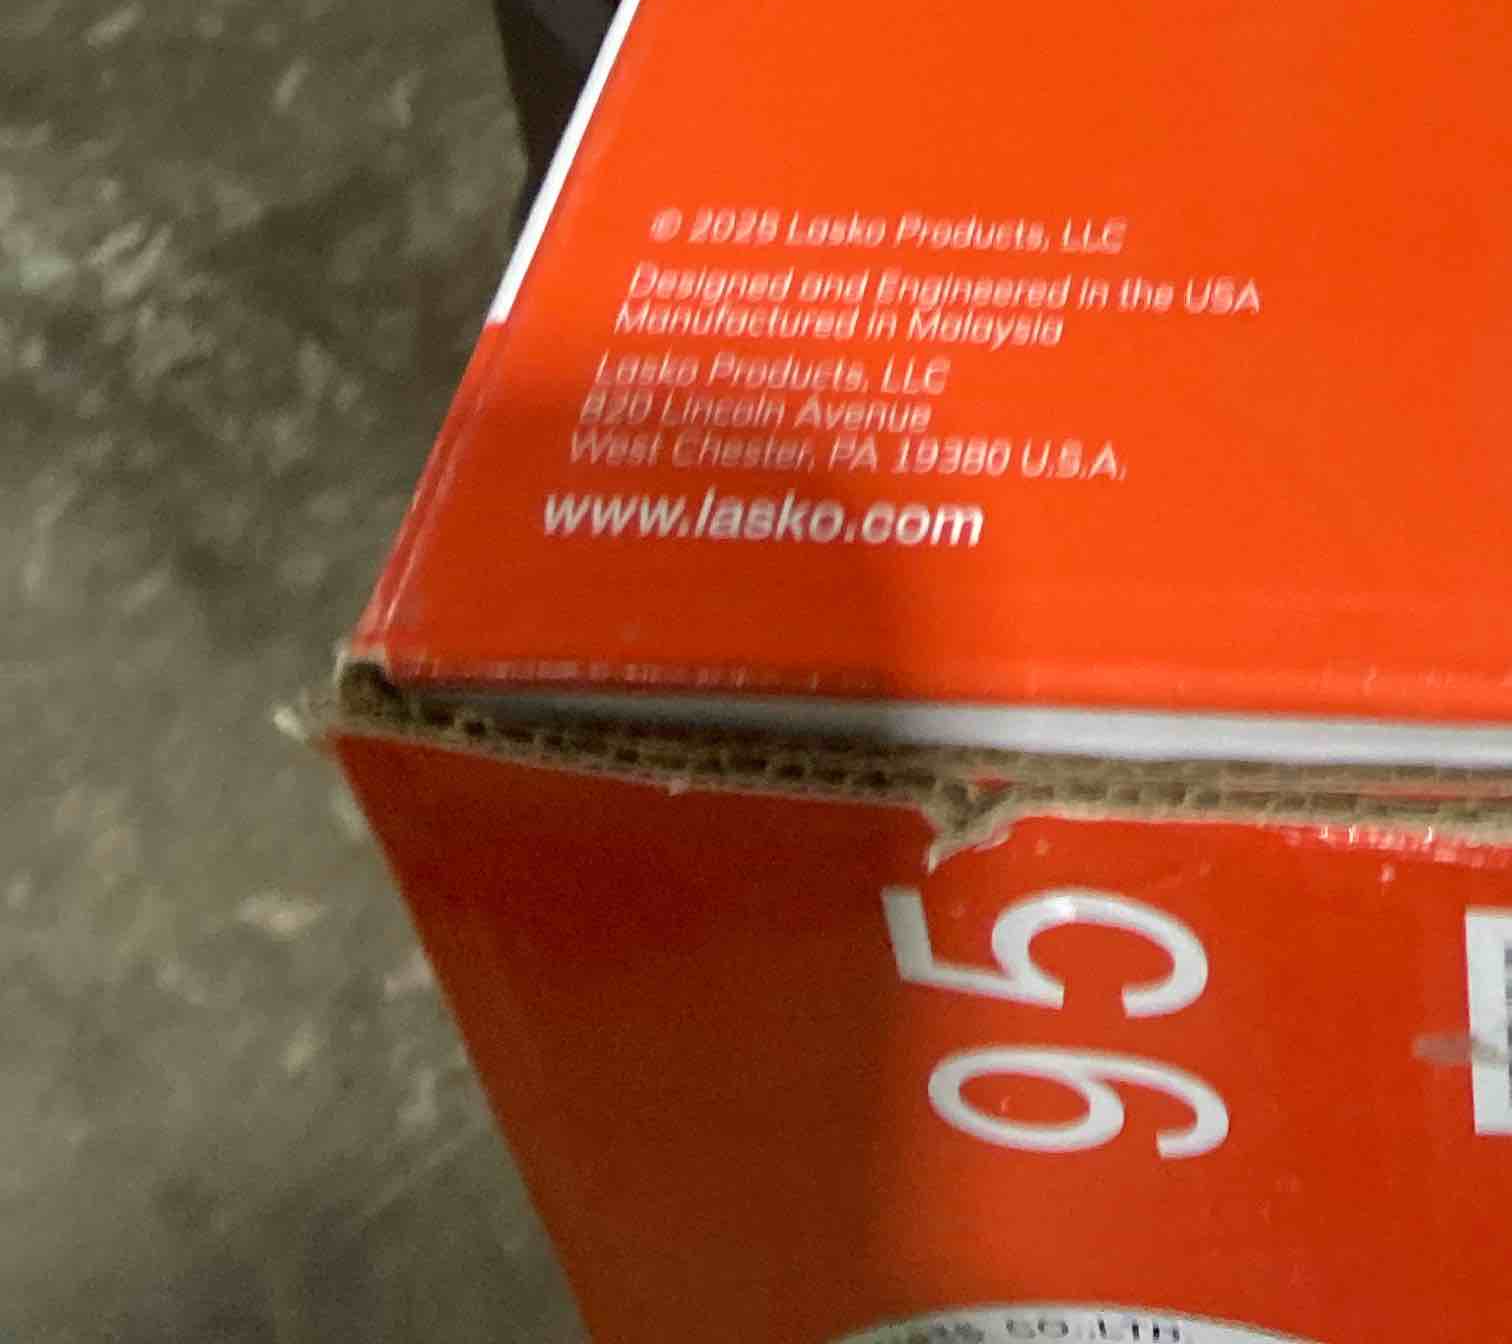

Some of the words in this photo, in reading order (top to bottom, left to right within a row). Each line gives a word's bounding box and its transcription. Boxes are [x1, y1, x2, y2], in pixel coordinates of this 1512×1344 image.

[651, 207, 683, 243] ©
[688, 208, 779, 244] 2025
[785, 210, 886, 248] Lasko
[895, 211, 1052, 252] Products,
[1059, 216, 1128, 253] LLC
[626, 261, 796, 304] Designed
[800, 269, 871, 304] and
[876, 266, 1073, 312] Engineered
[1077, 275, 1111, 311] in
[1118, 275, 1176, 312] the
[1184, 274, 1261, 316] USA
[613, 299, 861, 340] Manufactured
[865, 306, 897, 342] in
[905, 307, 1065, 352] Malaysia
[592, 351, 700, 388] Lasko
[706, 351, 870, 393] Products,
[880, 355, 951, 395] LLC
[578, 386, 653, 427] 820
[660, 388, 786, 430] Lincoln
[793, 391, 933, 434] Avenue
[568, 428, 664, 465] West
[671, 428, 816, 473] Chester,
[828, 433, 879, 473] PA
[890, 434, 1012, 478] 19380
[543, 485, 985, 548] www.lasko.com
[881, 885, 1231, 1161] 95
